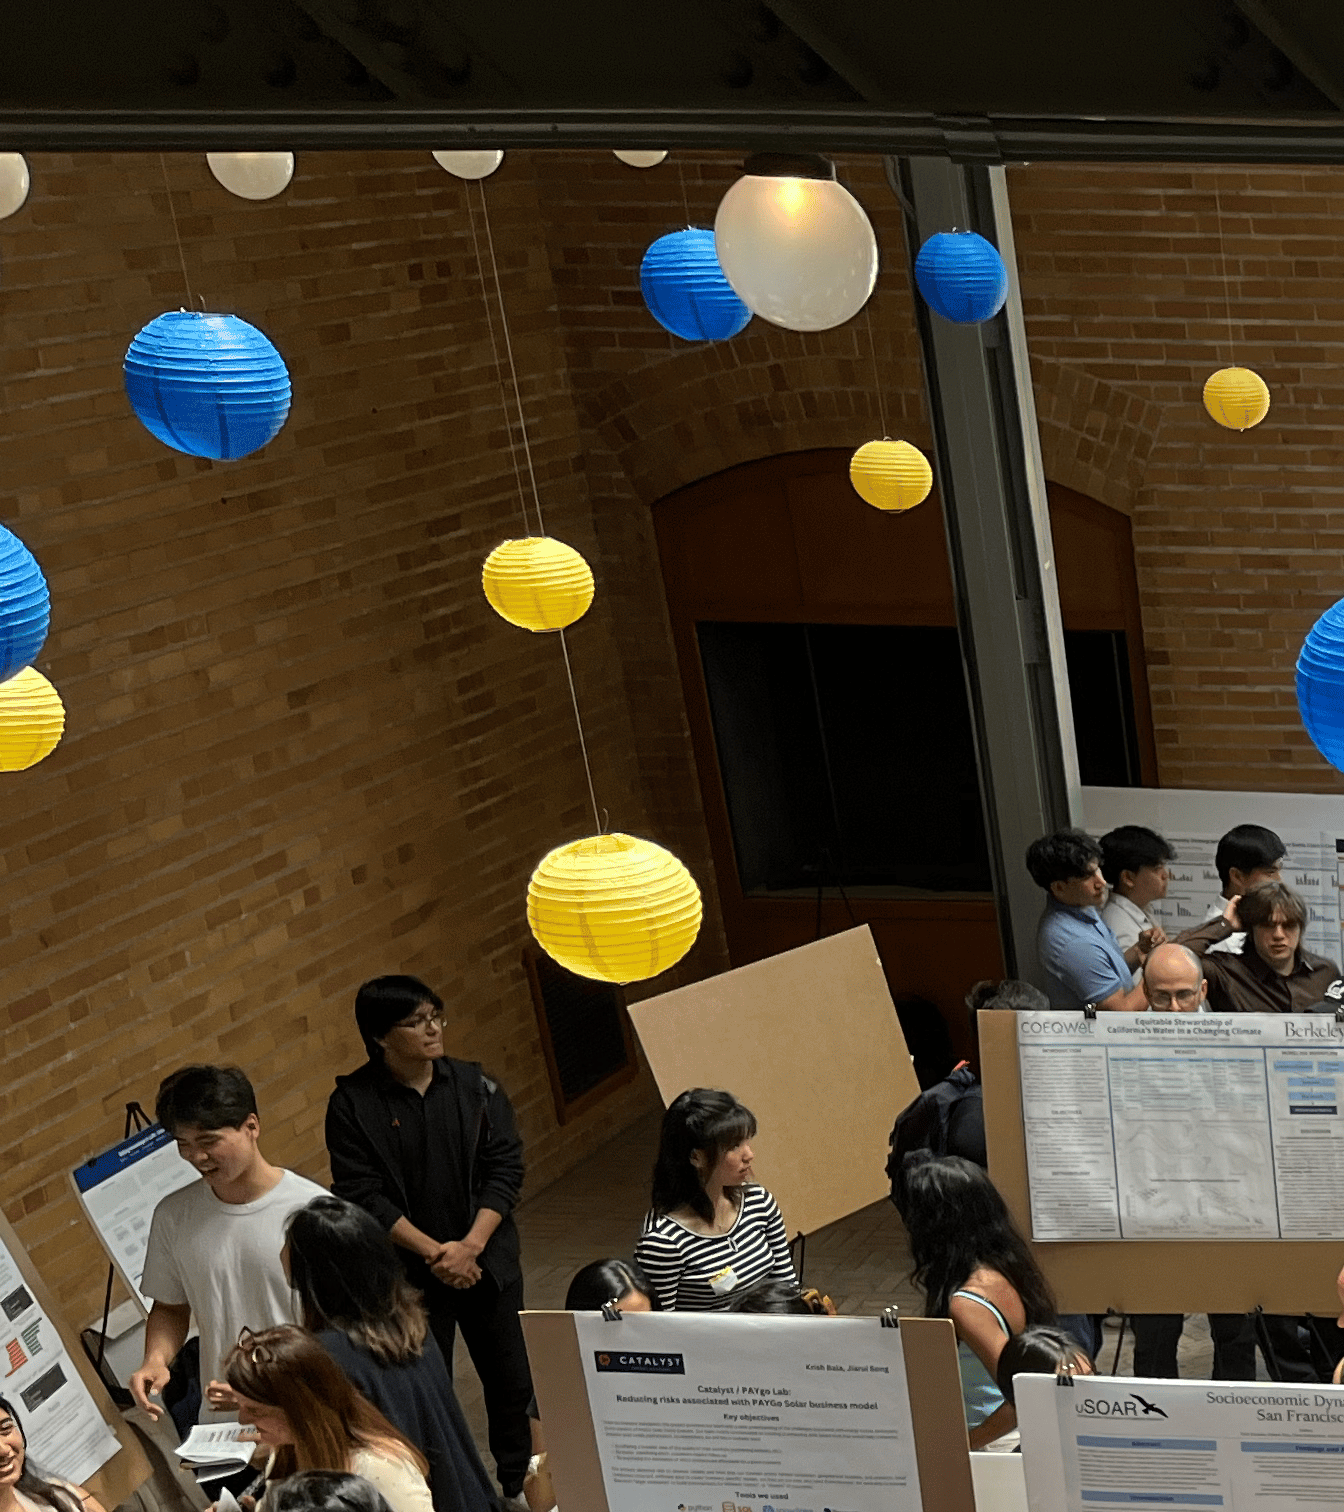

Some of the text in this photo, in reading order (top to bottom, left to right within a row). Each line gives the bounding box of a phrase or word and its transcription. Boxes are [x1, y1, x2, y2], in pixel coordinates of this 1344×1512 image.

[1135, 1018, 1233, 1027] Equitable Stewardship of
[1153, 1027, 1175, 1035] Water
[1193, 1028, 1229, 1037] Changing
[1232, 1027, 1262, 1036] Climate
[619, 1356, 680, 1366] CATALYST
[698, 1385, 734, 1394] Catalyst
[773, 1387, 791, 1395] Lab:
[616, 1395, 657, 1405] Reducing
[660, 1396, 680, 1404] risks
[683, 1398, 728, 1406] associated
[731, 1398, 750, 1406] with
[784, 1400, 807, 1409] Solar
[809, 1401, 847, 1410] business
[850, 1401, 878, 1410] model
[1206, 1392, 1309, 1407] Socioeconomic
[1076, 1400, 1137, 1416] uSOAR
[723, 1414, 779, 1422] Key objectives
[1257, 1409, 1282, 1421] San
[688, 1504, 712, 1512] python
